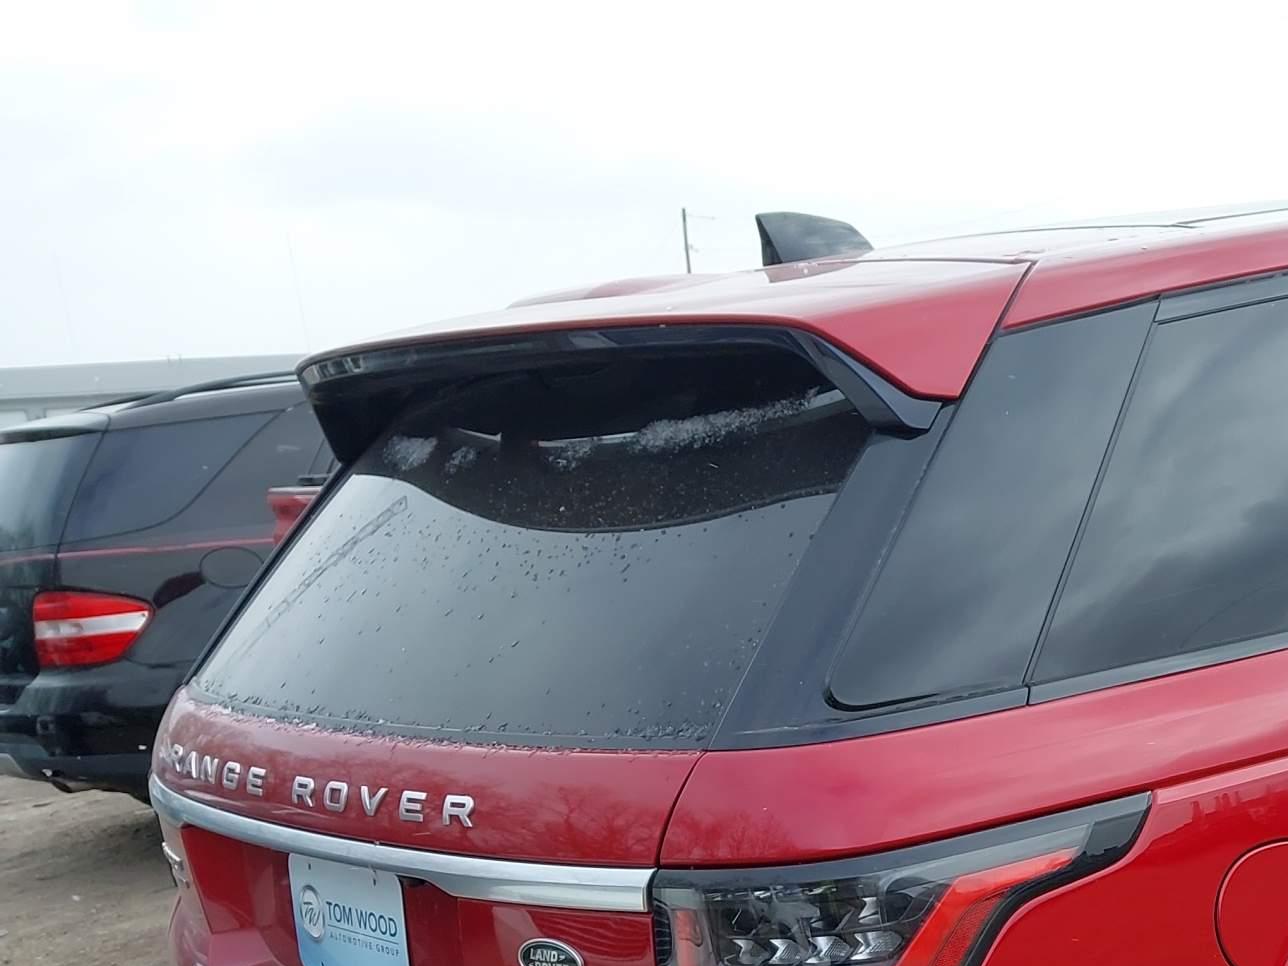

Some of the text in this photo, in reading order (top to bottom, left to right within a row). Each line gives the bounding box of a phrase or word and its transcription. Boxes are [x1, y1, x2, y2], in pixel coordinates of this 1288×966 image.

[167, 743, 476, 828] RANGE ROVER
[326, 900, 398, 937] TOM WOOD
[329, 931, 400, 957] AUTOMOTIVE GROUP
[530, 948, 558, 962] LAND
